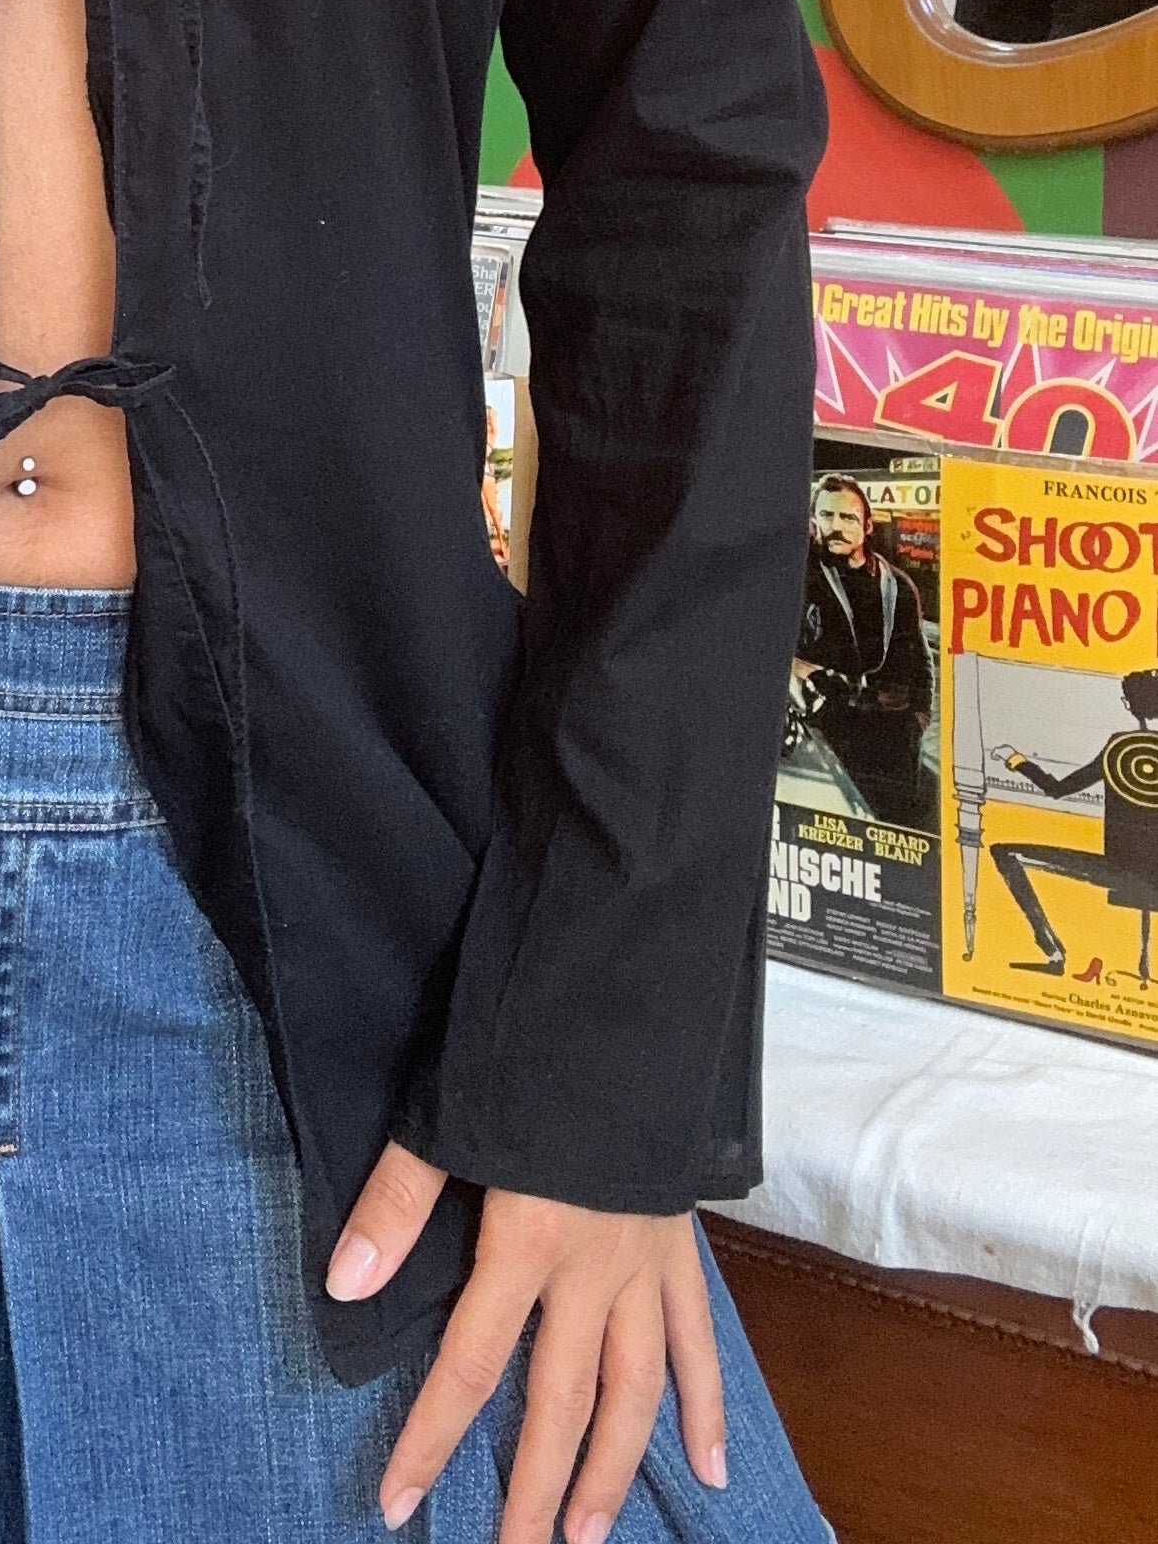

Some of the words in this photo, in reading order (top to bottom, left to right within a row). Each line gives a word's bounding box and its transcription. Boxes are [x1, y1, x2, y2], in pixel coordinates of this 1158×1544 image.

[822, 283, 908, 331] Great
[908, 292, 970, 337] Hits
[973, 298, 1011, 348] by
[1017, 304, 1069, 349] the
[873, 349, 1138, 462] 40
[1044, 479, 1148, 505] FRANCOIS
[950, 577, 1142, 655] PIANO
[798, 823, 864, 853] KREUZER
[813, 813, 849, 835] LISA
[865, 825, 931, 855] GERARD
[874, 842, 924, 868] BLAIN
[769, 839, 883, 903] NISCHE
[767, 876, 812, 923] ND
[1069, 992, 1111, 1012] Charles
